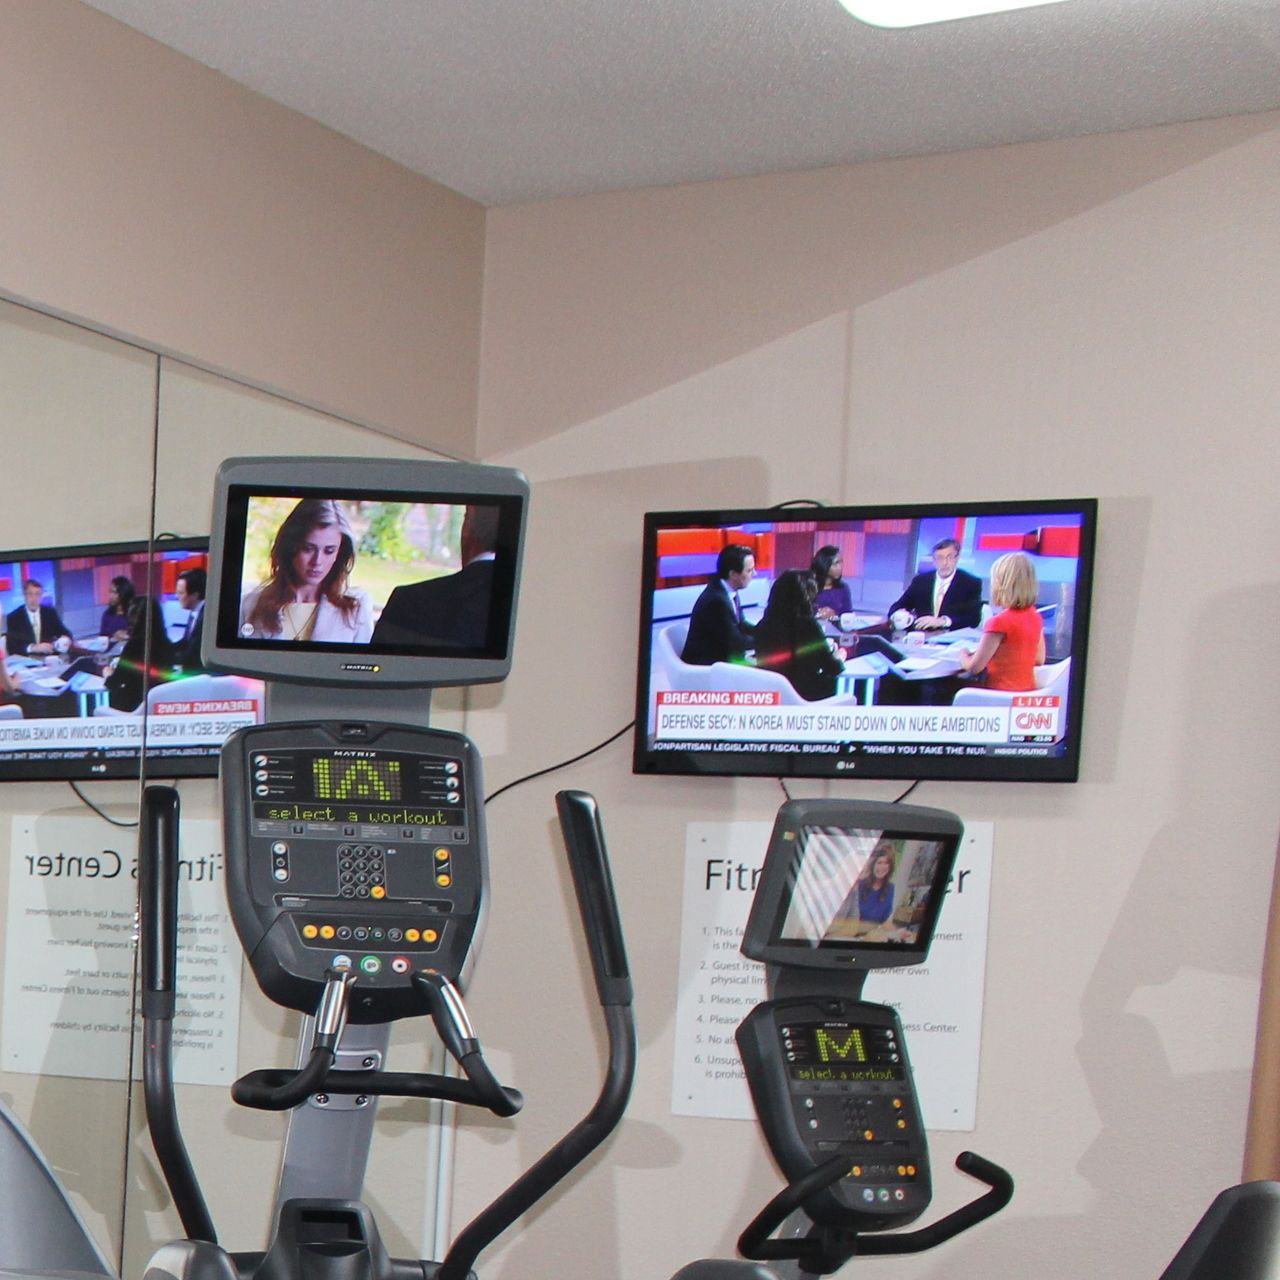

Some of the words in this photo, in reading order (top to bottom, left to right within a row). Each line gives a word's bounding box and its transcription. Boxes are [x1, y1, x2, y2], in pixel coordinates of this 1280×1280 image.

[663, 693, 731, 705] BREAKING
[734, 693, 774, 705] NEWS
[1017, 697, 1054, 707] LIVE
[661, 714, 706, 730] DEFENSE
[708, 715, 737, 731] SECY:
[739, 716, 747, 730] N
[749, 715, 784, 731] KOREA
[786, 716, 816, 731] MUST
[817, 716, 852, 732] STAND
[854, 716, 888, 731] DOWN
[891, 716, 907, 731] ON
[909, 716, 938, 731] NUKE
[941, 716, 1001, 733] AMBITIONS
[1015, 713, 1052, 729] CNN
[334, 750, 376, 758] MATRIX
[713, 743, 768, 752] LEGISLATIVE
[769, 744, 801, 752] FISCAL
[802, 744, 841, 754] BUREAU
[896, 745, 918, 754] YOU
[919, 745, 944, 755] TAKE
[945, 746, 965, 755] THE
[269, 805, 336, 823] select
[348, 811, 359, 823] a
[369, 809, 447, 825] workout
[715, 926, 733, 937] This
[722, 940, 739, 950] the
[712, 960, 740, 970] Guest
[742, 961, 750, 971] is
[907, 967, 930, 976] own
[711, 975, 750, 986] physical
[745, 997, 758, 1005] no
[709, 1014, 739, 1025] Please
[922, 1021, 959, 1033] Center.
[708, 1034, 722, 1044] No
[816, 1029, 865, 1062] M
